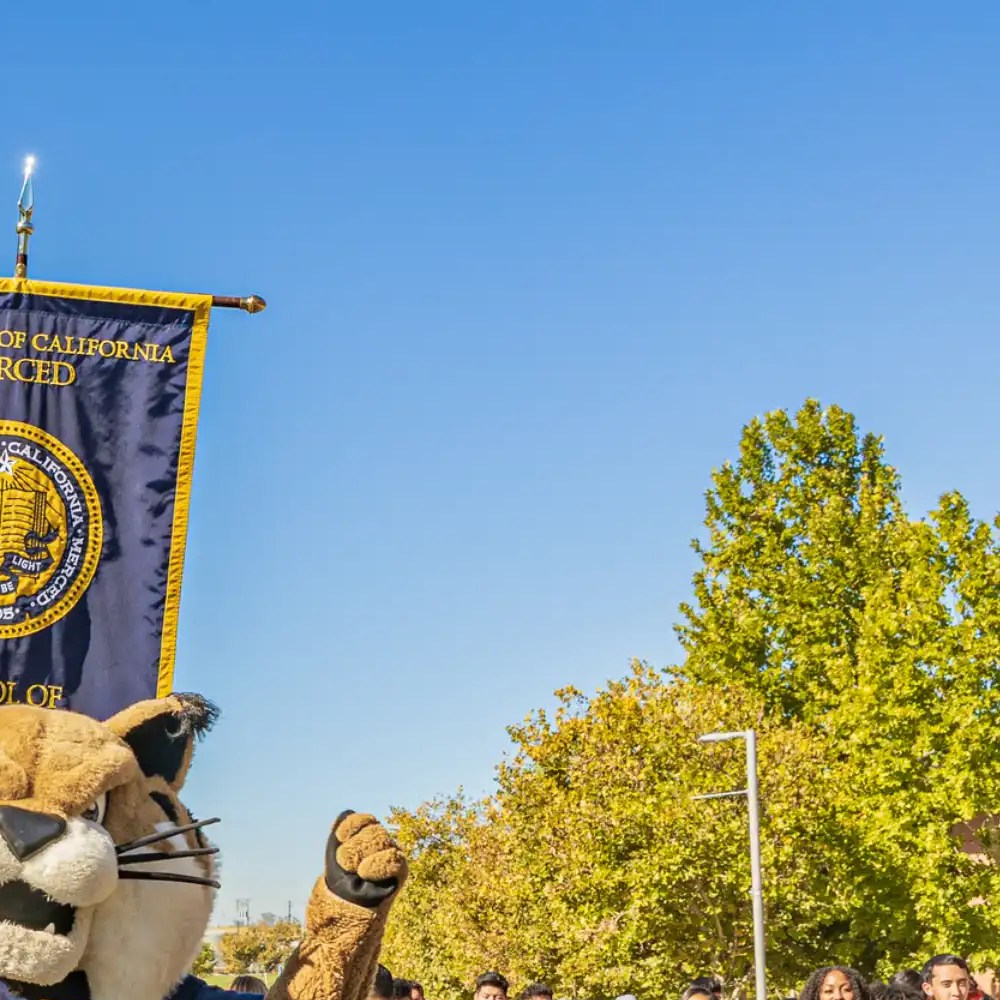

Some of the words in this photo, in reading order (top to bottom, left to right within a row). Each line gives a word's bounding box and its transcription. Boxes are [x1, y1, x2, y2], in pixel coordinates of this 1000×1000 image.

[31, 333, 176, 363] CALIFORNIA
[7, 440, 85, 532] CALIFORNIA
[0, 581, 15, 594] BE
[11, 554, 42, 572] LIGHT
[35, 537, 85, 607] MERCED
[26, 684, 64, 709] OF
